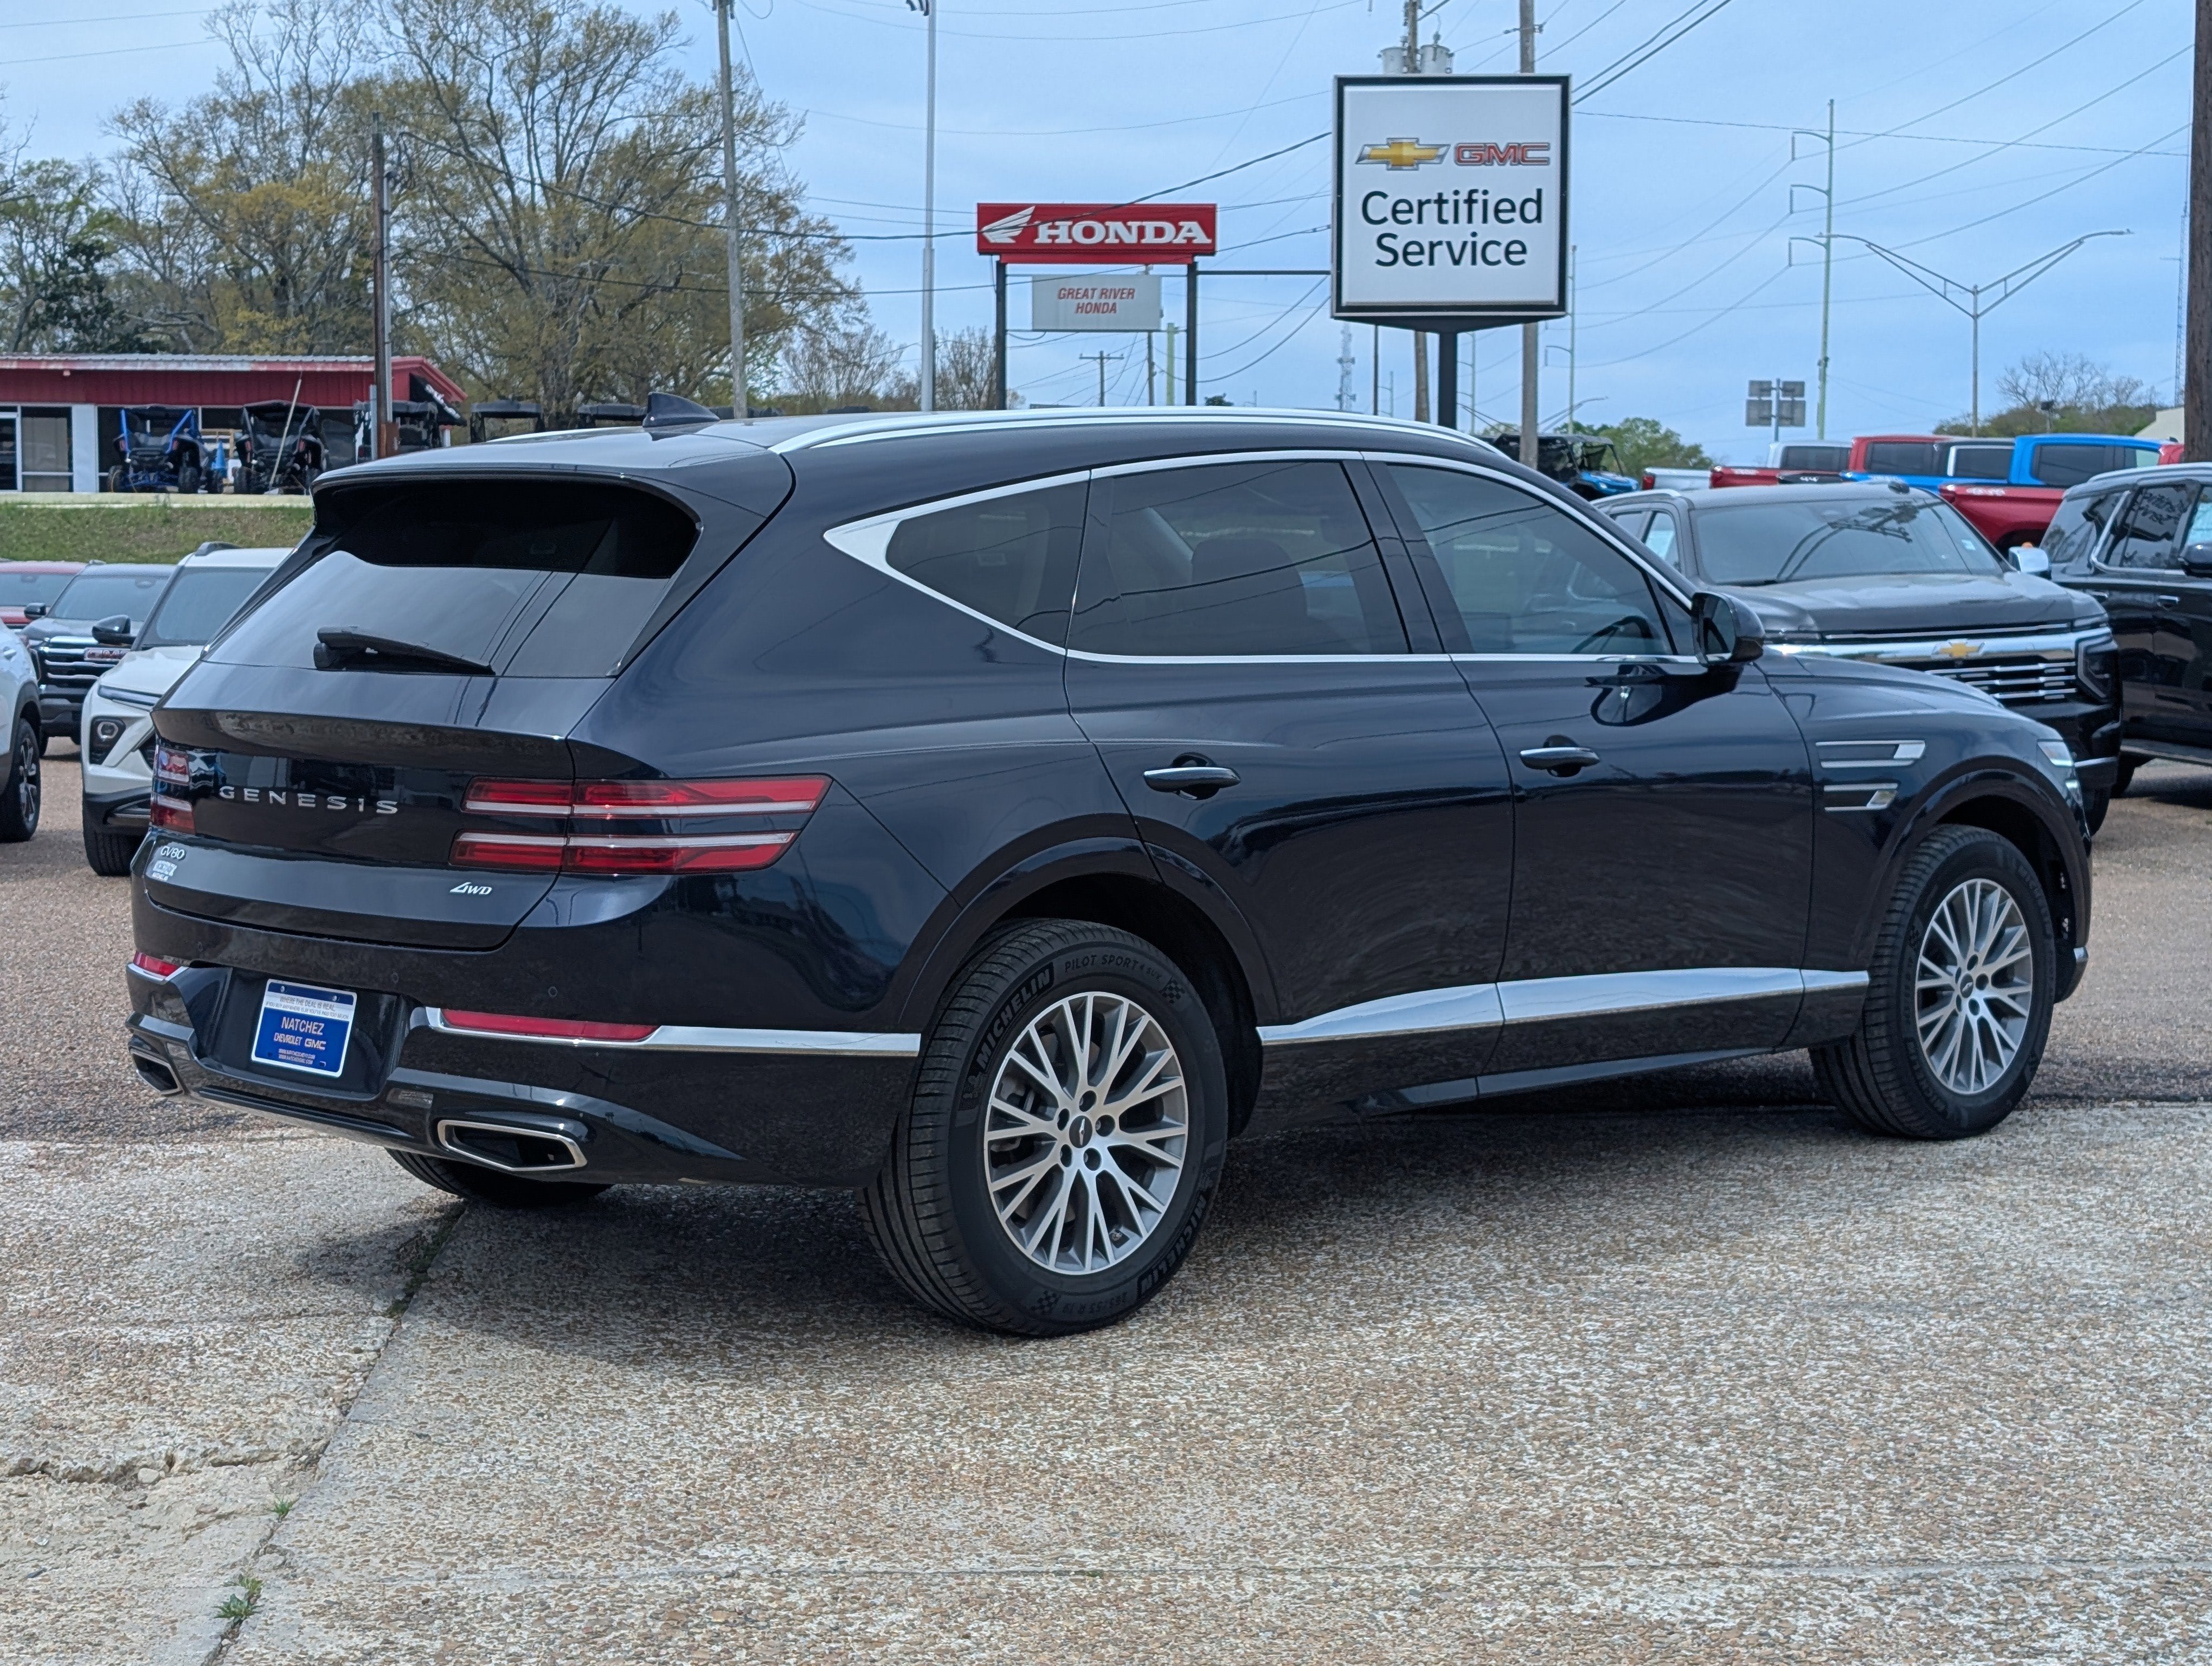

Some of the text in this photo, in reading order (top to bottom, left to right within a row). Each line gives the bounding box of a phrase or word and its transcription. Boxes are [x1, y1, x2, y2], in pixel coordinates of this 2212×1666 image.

[1454, 143, 1550, 166] GMC
[1362, 189, 1542, 225] Certified
[1033, 221, 1212, 244] HONDA
[1375, 232, 1527, 266] Service
[1058, 287, 1135, 299] GREAT RIVER
[1075, 302, 1117, 314] HONDA
[219, 786, 398, 813] GENESIS
[160, 845, 185, 860] GV80
[1065, 954, 1097, 972] PILOT
[1102, 954, 1139, 971] SPORT
[281, 1016, 324, 1035] NATCHEZ
[977, 969, 1050, 1069] MICHELIN
[273, 1032, 326, 1050] CHEVROLET GMC
